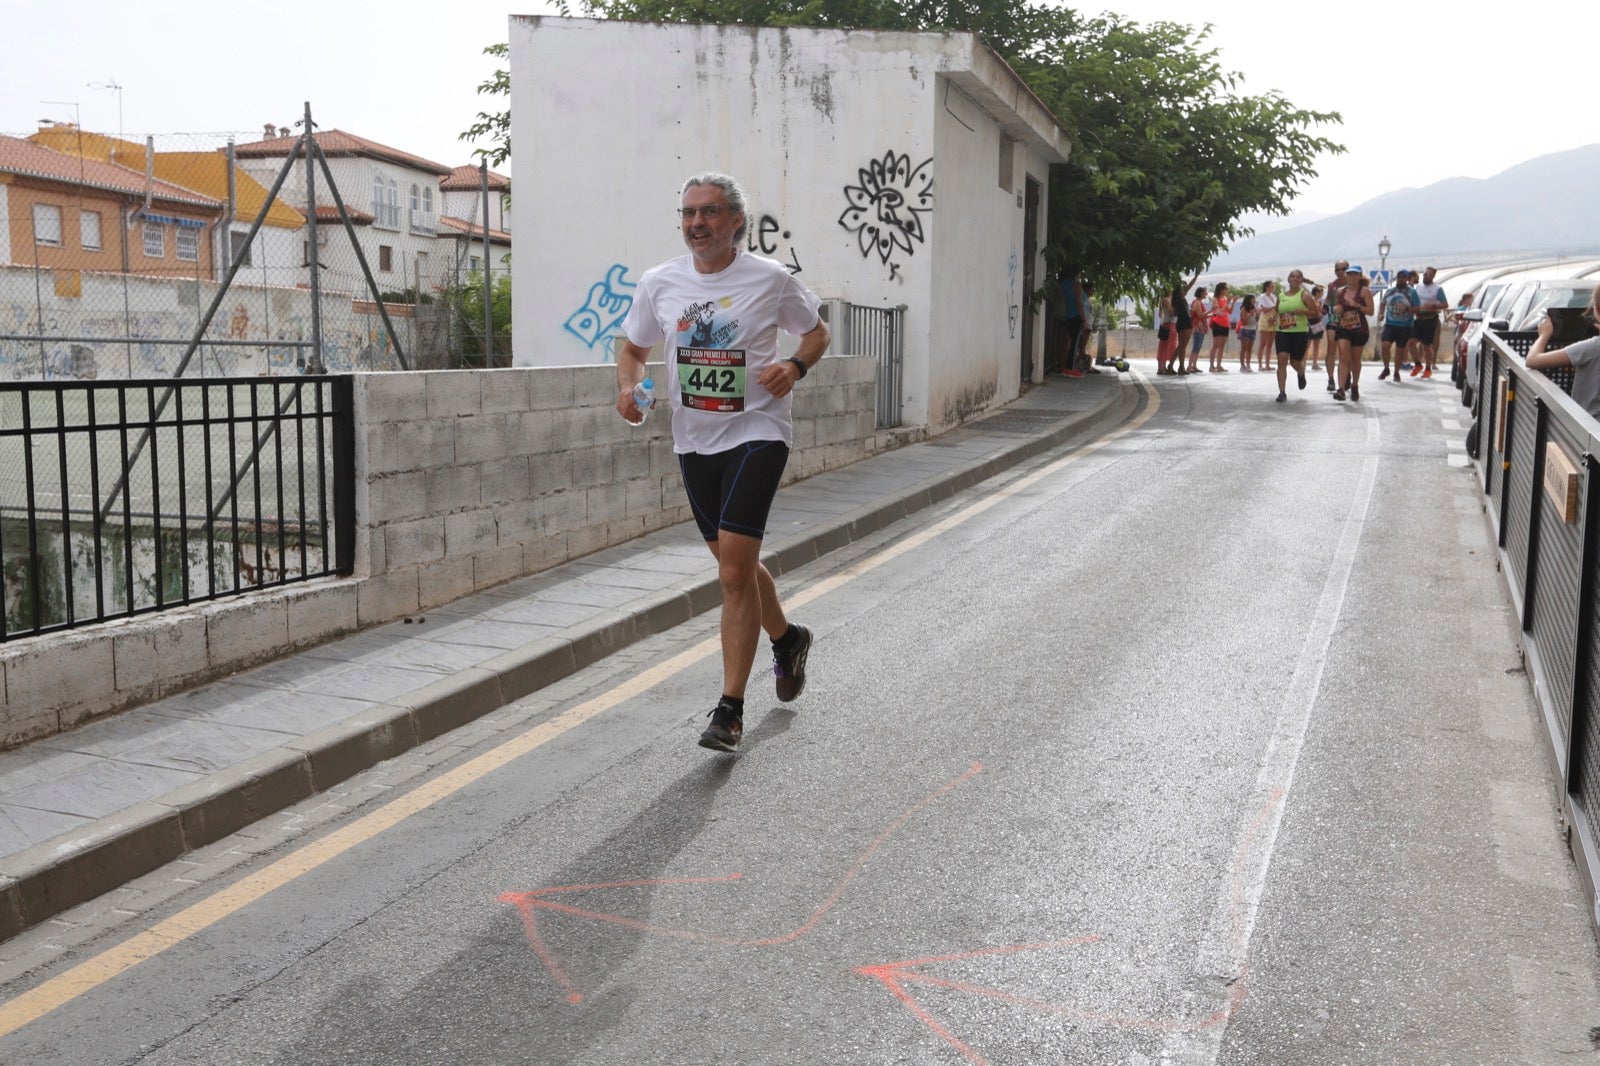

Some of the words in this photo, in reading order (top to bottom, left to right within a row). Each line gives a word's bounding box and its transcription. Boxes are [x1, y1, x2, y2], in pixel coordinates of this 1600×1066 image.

[691, 349, 704, 358] GRAN
[704, 350, 721, 359] PREMIO
[721, 351, 728, 359] DE
[728, 351, 743, 360] FONDO
[688, 367, 736, 393] 442
